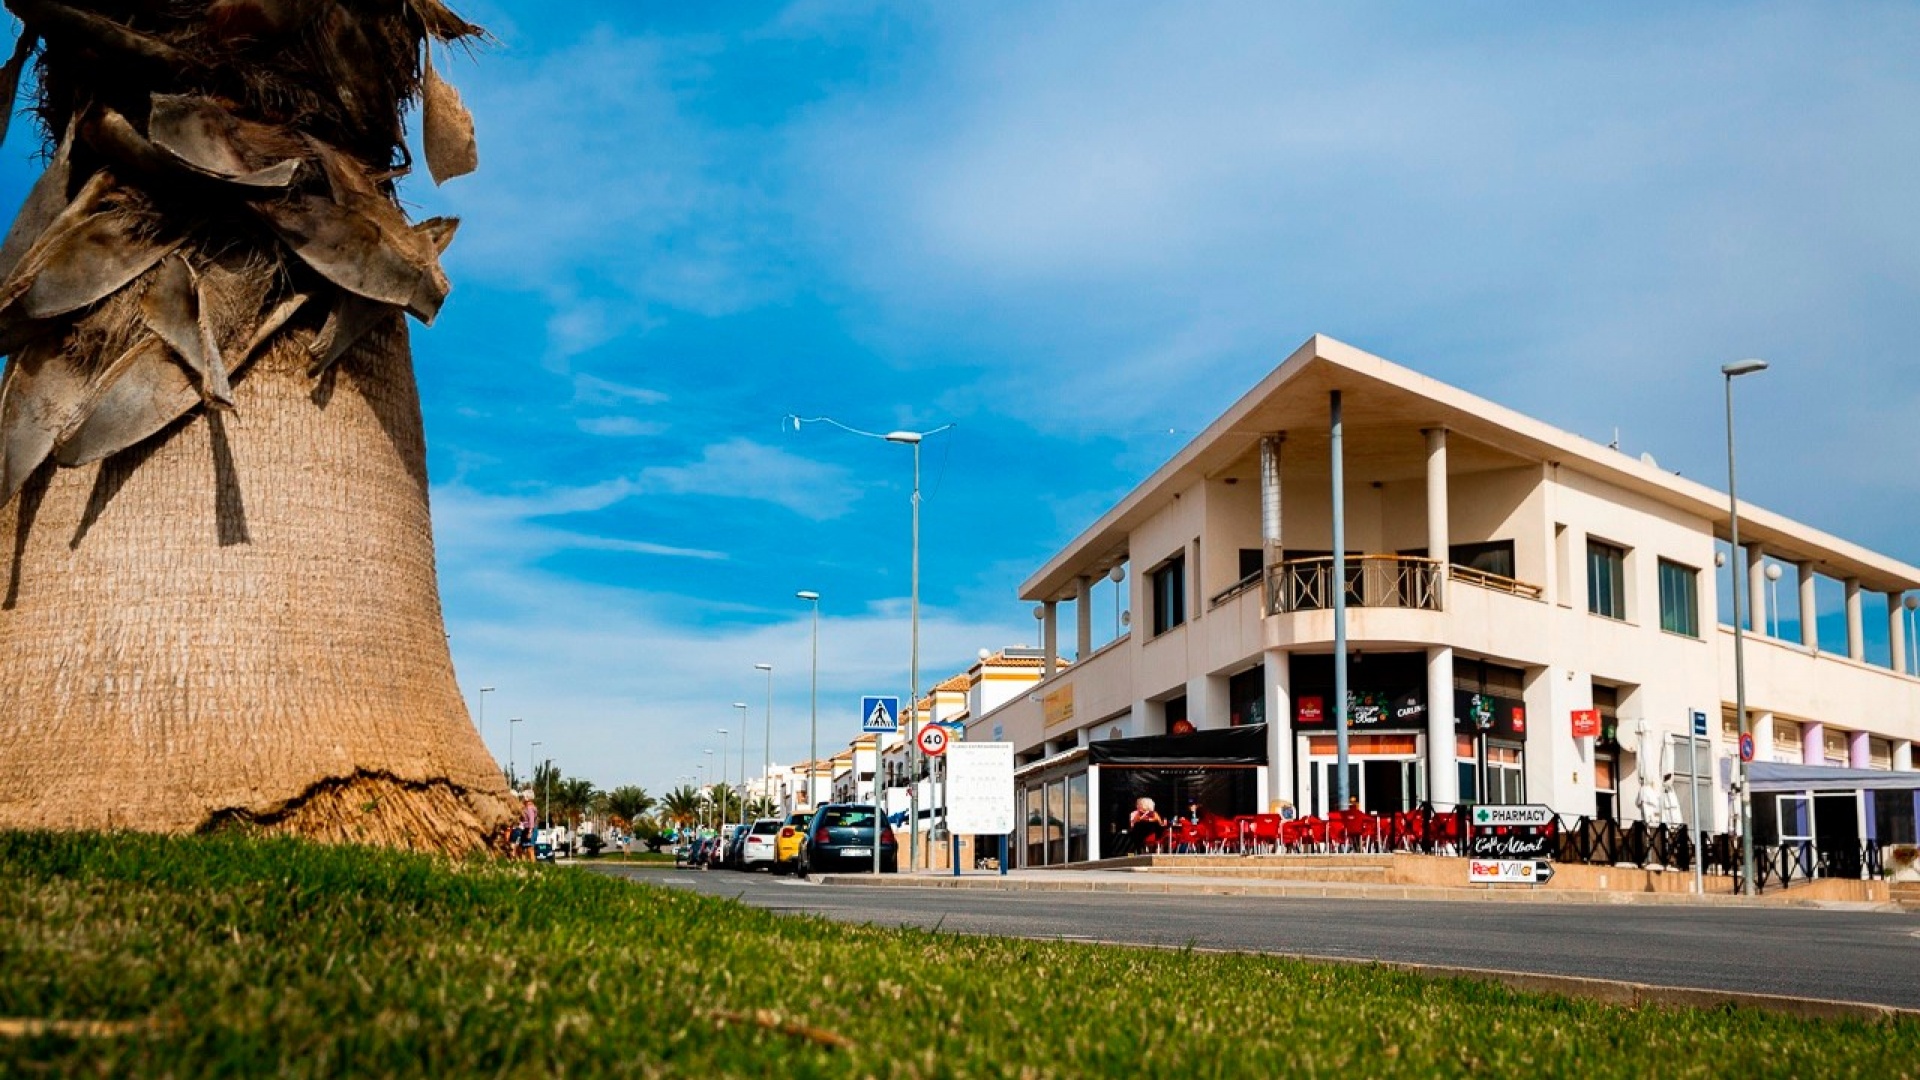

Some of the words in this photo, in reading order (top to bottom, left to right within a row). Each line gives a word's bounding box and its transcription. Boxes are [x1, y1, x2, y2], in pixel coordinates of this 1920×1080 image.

[924, 734, 943, 744] 40
[1492, 810, 1546, 821] PHARMACY
[1473, 861, 1499, 875] Red
